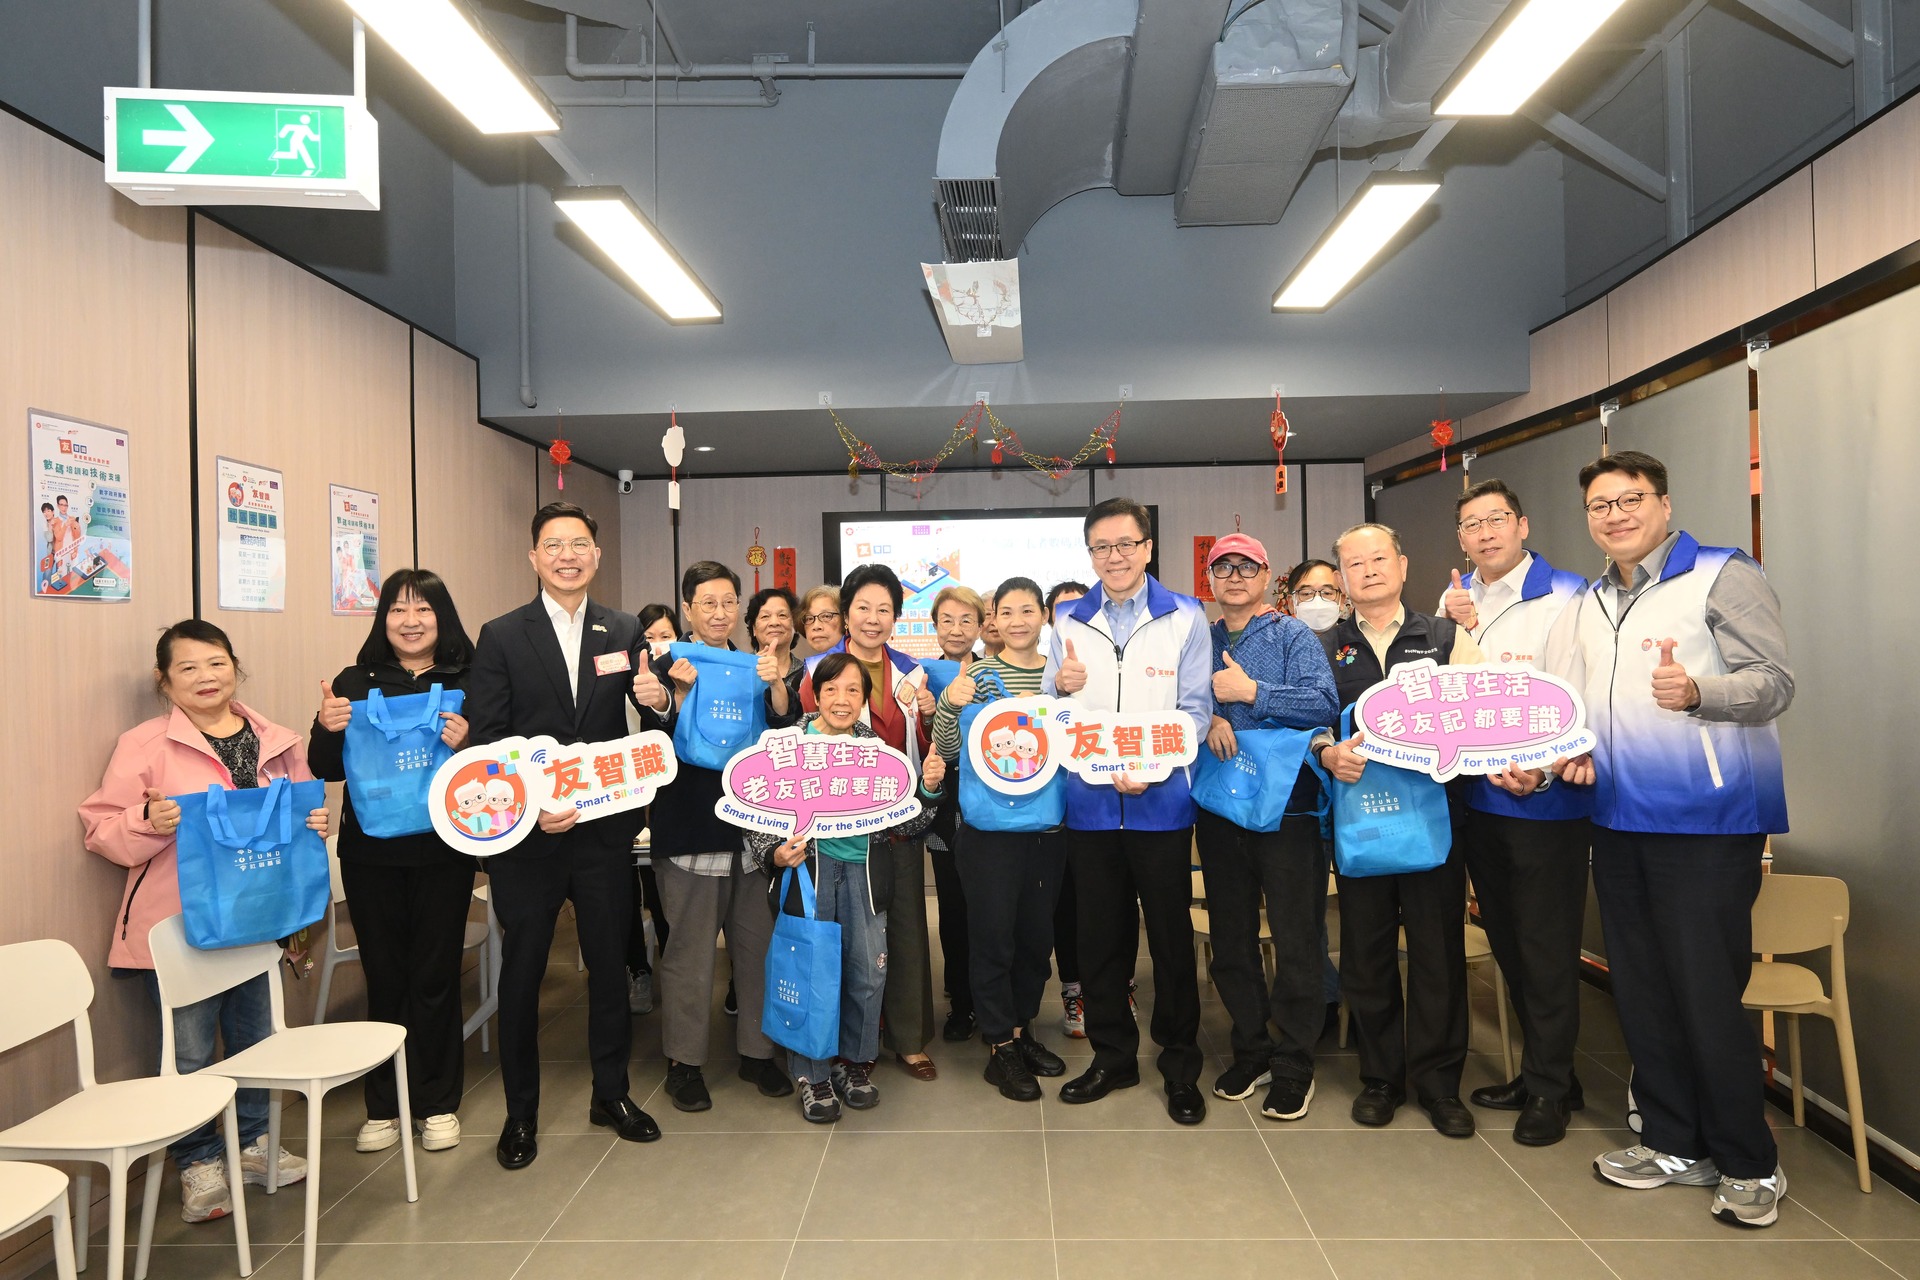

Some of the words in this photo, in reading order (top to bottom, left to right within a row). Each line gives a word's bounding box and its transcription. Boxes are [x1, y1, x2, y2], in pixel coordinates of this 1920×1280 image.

[43, 459, 121, 482] 數碼培訓和技術支援
[1397, 666, 1532, 704] 智慧生活
[1376, 705, 1563, 738] 老友記都要識
[766, 734, 879, 771] 智慧生活
[1065, 721, 1188, 761] 友智識
[1360, 739, 1393, 758] Smart
[1395, 750, 1431, 766] Living
[1463, 757, 1481, 768] for
[1486, 757, 1507, 767] the
[1511, 751, 1547, 764] Silver
[1550, 736, 1587, 755] Years
[543, 743, 668, 801] 友智識
[1091, 763, 1126, 773] Smart
[1128, 761, 1161, 772] Silver
[575, 794, 611, 810] Smart
[613, 785, 645, 800] Silver
[742, 774, 900, 803] 老友記都要識
[722, 803, 755, 822] Smart
[757, 815, 789, 831] Living
[816, 822, 833, 832] for
[836, 821, 853, 831] the
[855, 815, 885, 829] Silver
[887, 803, 916, 821] Years
[249, 850, 280, 861] FUND
